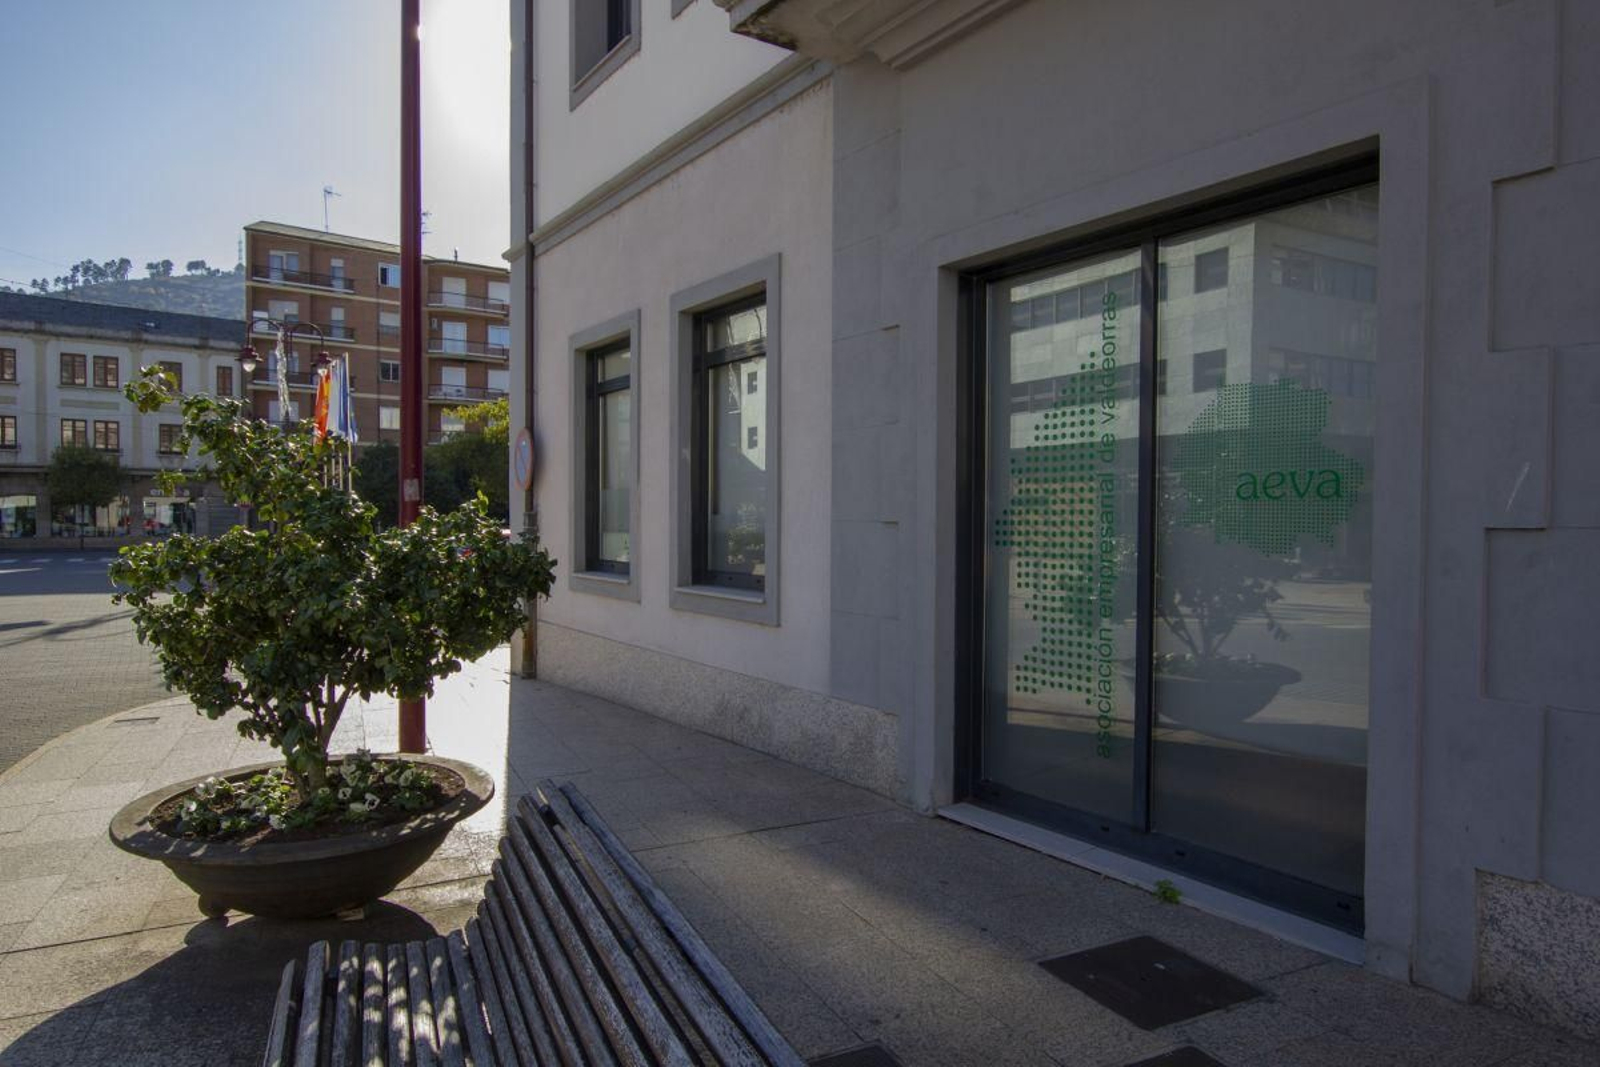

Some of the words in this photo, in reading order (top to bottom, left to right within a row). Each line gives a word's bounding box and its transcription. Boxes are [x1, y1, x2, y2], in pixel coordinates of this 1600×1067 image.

[1096, 292, 1117, 424] valdeorras
[1096, 433, 1115, 463] de
[1236, 469, 1344, 500] aeva
[1097, 473, 1118, 618] empresarial
[1093, 628, 1112, 758] asociación
